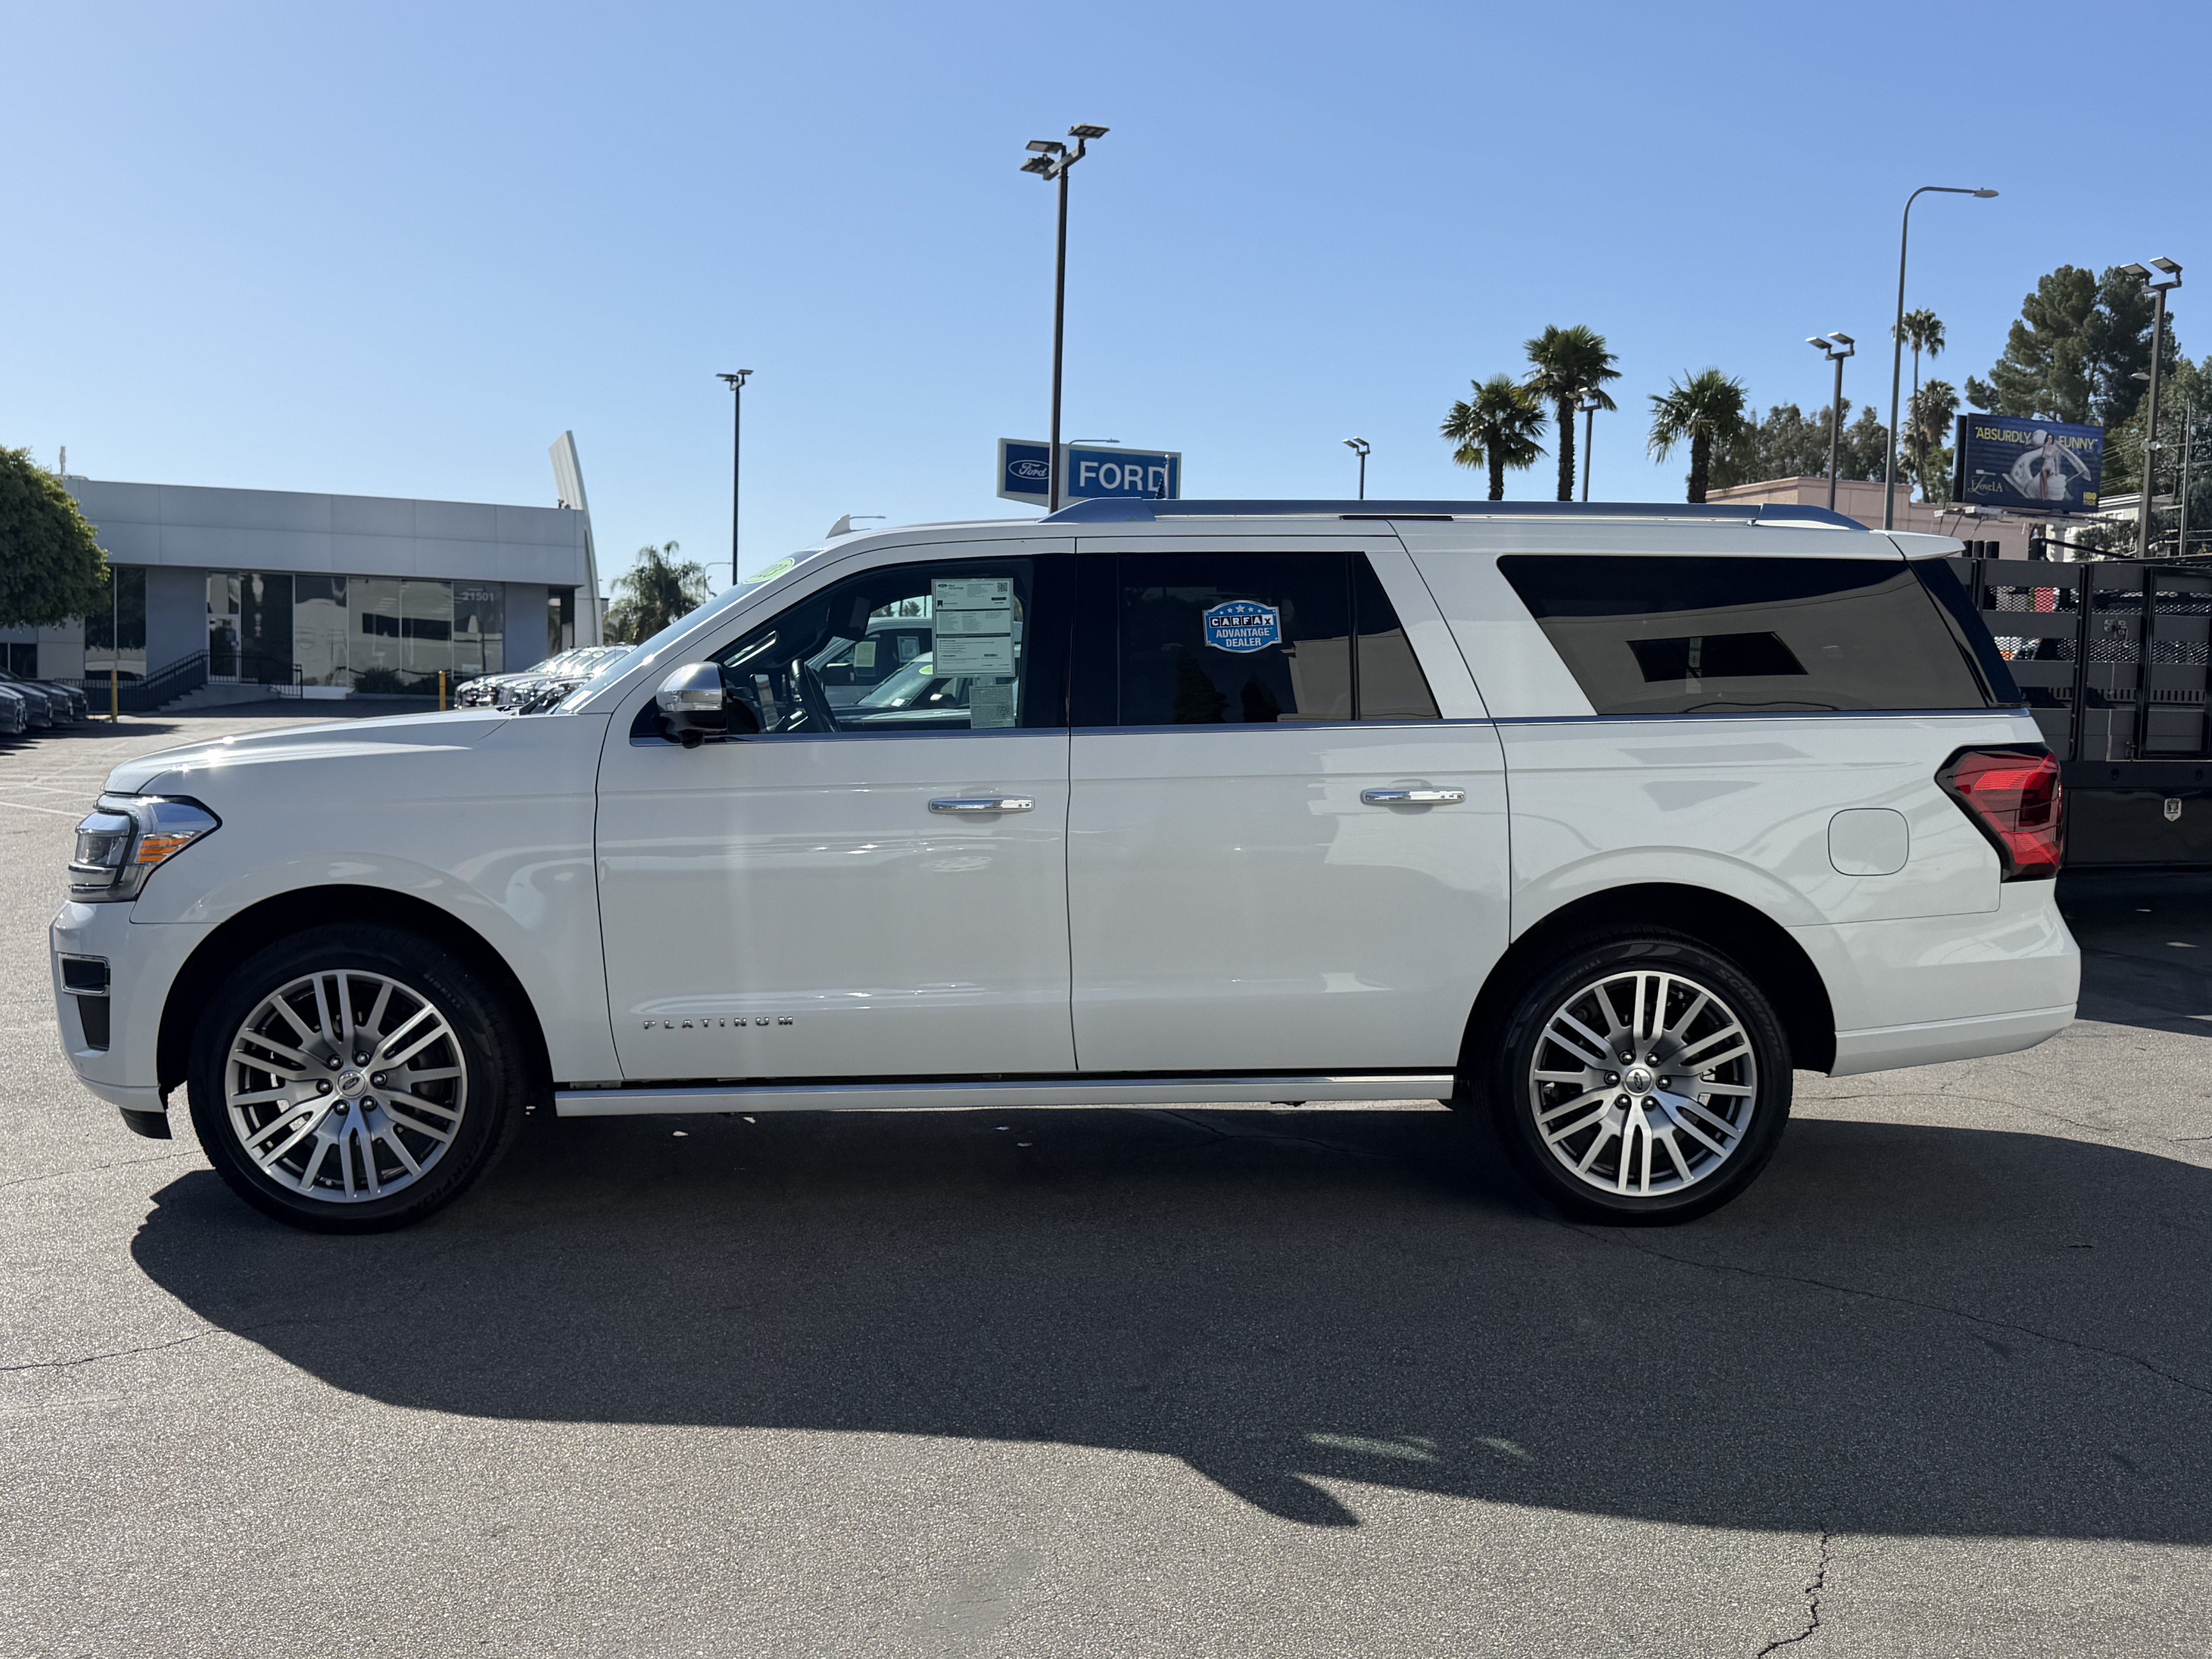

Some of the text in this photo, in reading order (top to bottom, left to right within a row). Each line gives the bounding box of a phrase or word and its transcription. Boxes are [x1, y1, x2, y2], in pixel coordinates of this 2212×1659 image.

[1018, 462, 1047, 476] Ford
[1079, 460, 1165, 491] FORD
[464, 591, 494, 602] 21501
[1212, 616, 1271, 626] CARFAX
[1216, 628, 1270, 638] ADVANTAGE
[1226, 638, 1261, 647] DEALER
[643, 1016, 793, 1029] PLATINUM
